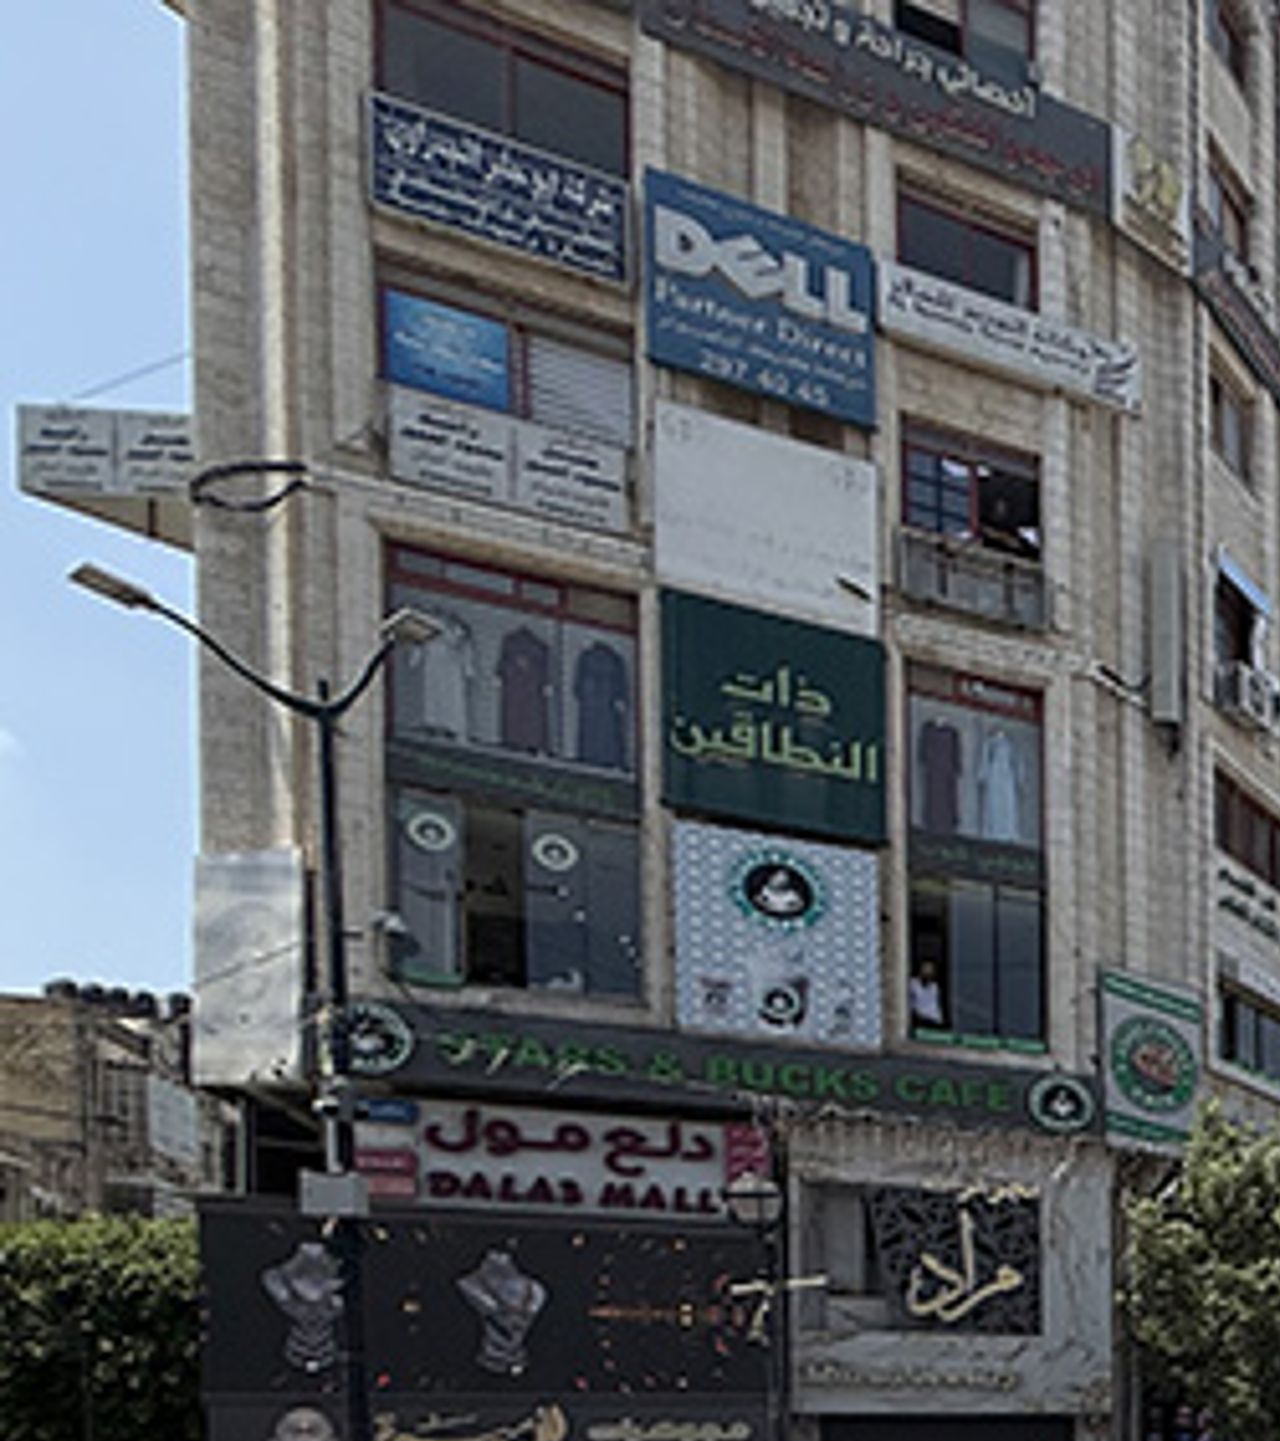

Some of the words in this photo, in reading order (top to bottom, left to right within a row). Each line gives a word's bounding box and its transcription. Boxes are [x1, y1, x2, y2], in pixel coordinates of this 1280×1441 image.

[655, 204, 867, 333] DELL
[655, 276, 767, 332] Partner
[777, 318, 866, 369] Direct
[670, 711, 877, 783] النطاقين
[704, 1053, 881, 1100] BUCKS
[896, 1073, 1010, 1111] CAFE
[424, 1109, 591, 1156] مول
[603, 1120, 714, 1176] دلع
[599, 1181, 723, 1214] MALL
